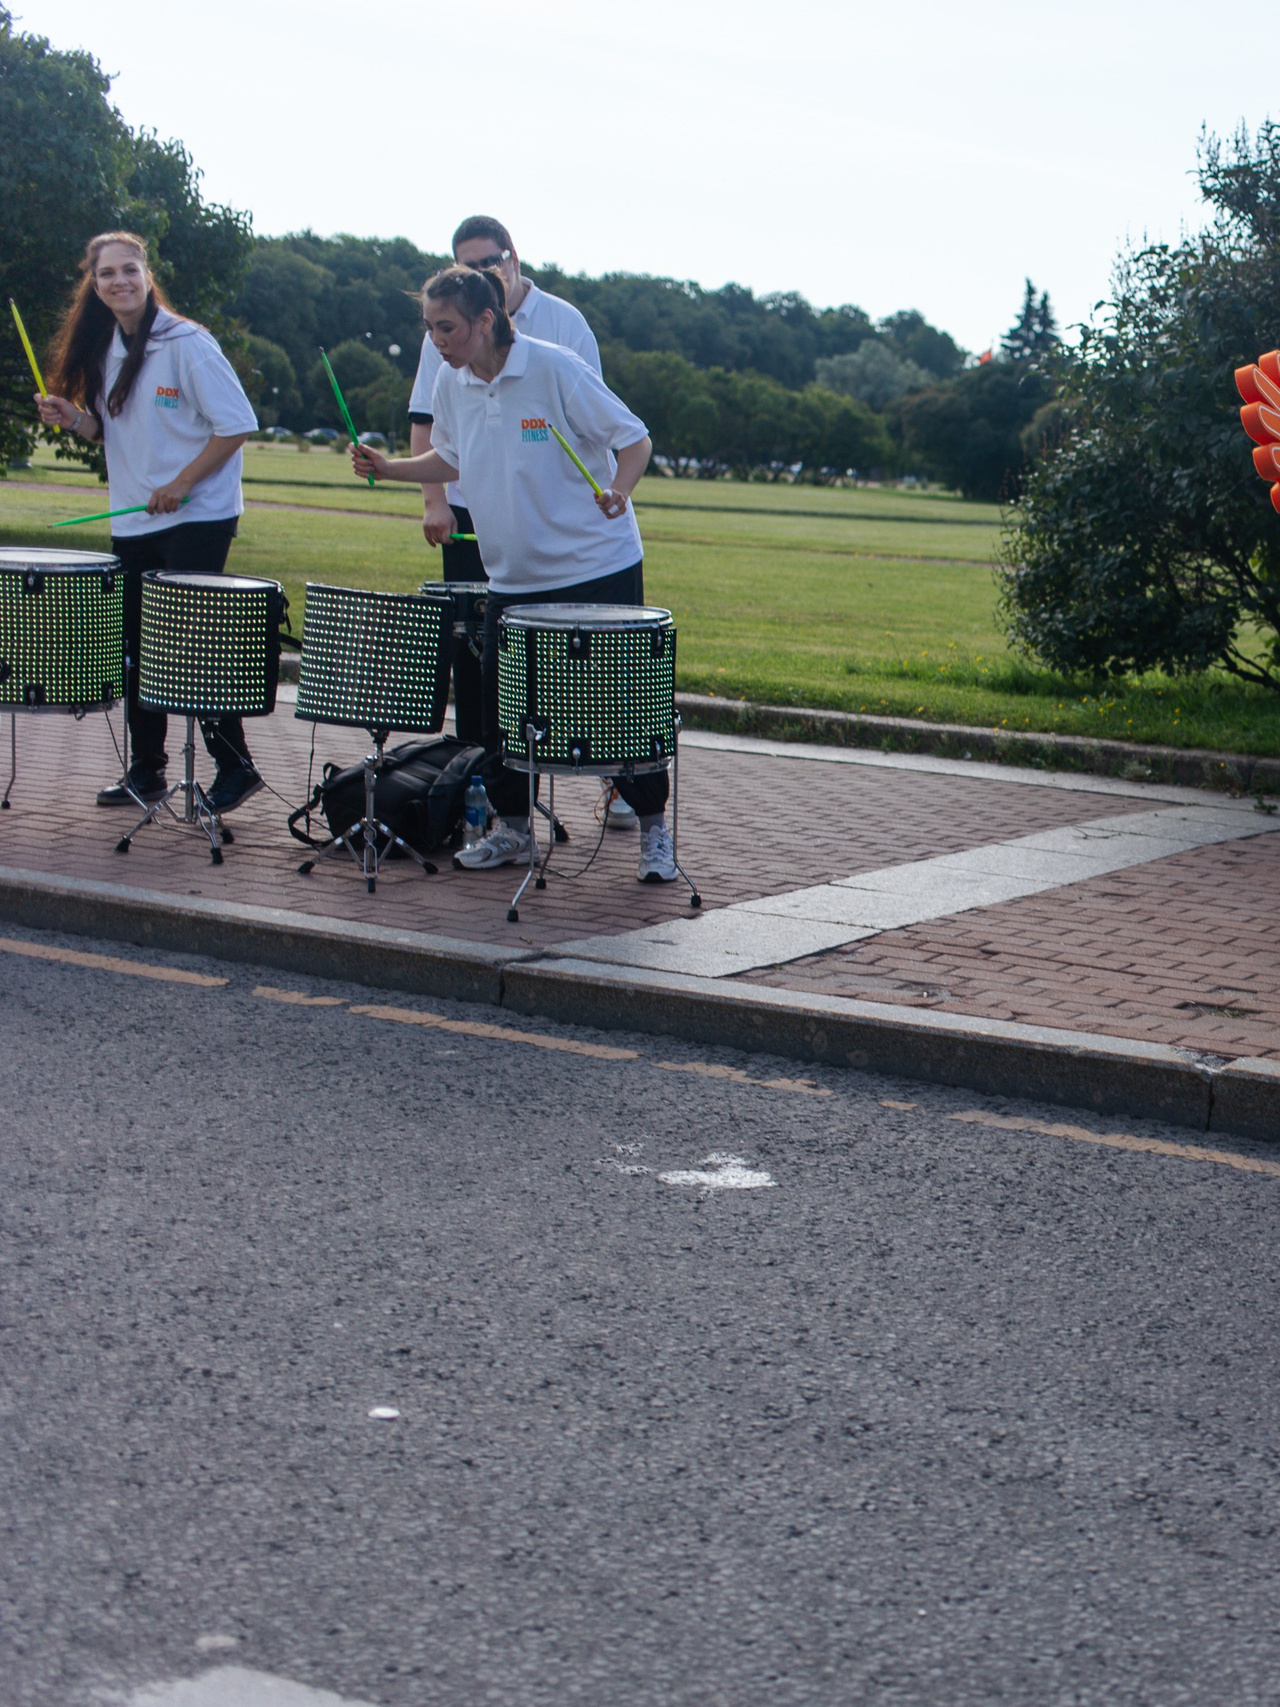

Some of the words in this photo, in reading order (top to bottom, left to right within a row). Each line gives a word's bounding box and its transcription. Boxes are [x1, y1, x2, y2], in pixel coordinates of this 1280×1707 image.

[156, 386, 179, 398] DDX
[521, 418, 547, 430] DDX
[521, 429, 549, 442] FITNESS
